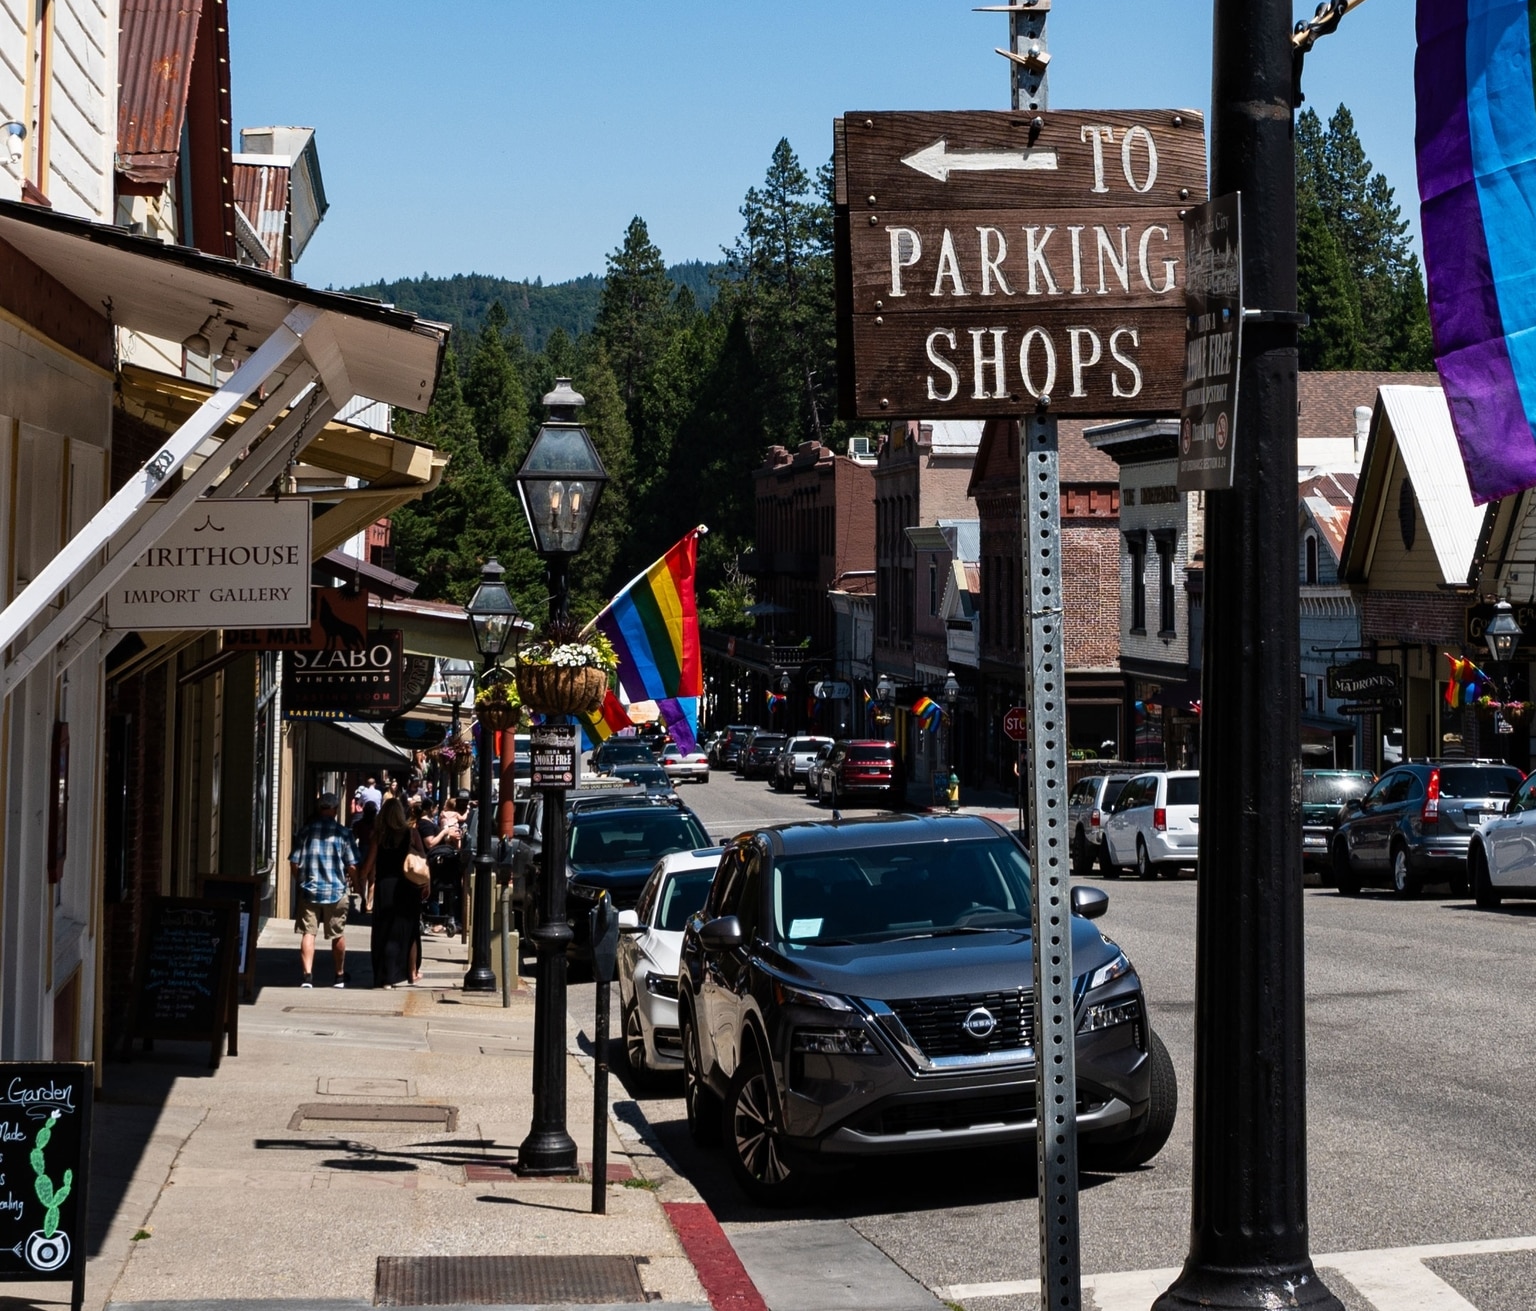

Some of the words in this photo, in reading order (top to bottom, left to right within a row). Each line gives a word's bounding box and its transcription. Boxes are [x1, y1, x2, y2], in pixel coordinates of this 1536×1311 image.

[1080, 125, 1160, 194] TO
[885, 224, 1180, 298] PARKING
[926, 325, 1143, 402] SHOPS
[1207, 331, 1233, 378] FREE
[133, 544, 299, 568] IRITHOUSE
[124, 588, 200, 604] IMPORT
[210, 587, 292, 603] GALLERY
[224, 629, 263, 645] DEL
[266, 629, 313, 645] MAR
[293, 644, 393, 669] SZABO
[295, 675, 391, 684] VINEYARDS
[354, 692, 392, 702] ROOM
[289, 709, 336, 719] RARITIES
[1006, 717, 1027, 730] STO
[534, 754, 554, 765] SMOKE
[555, 754, 572, 765] FREE
[961, 1018, 998, 1029] NISSAN
[8, 1077, 75, 1108] Garden
[0, 1190, 24, 1221] ealing
